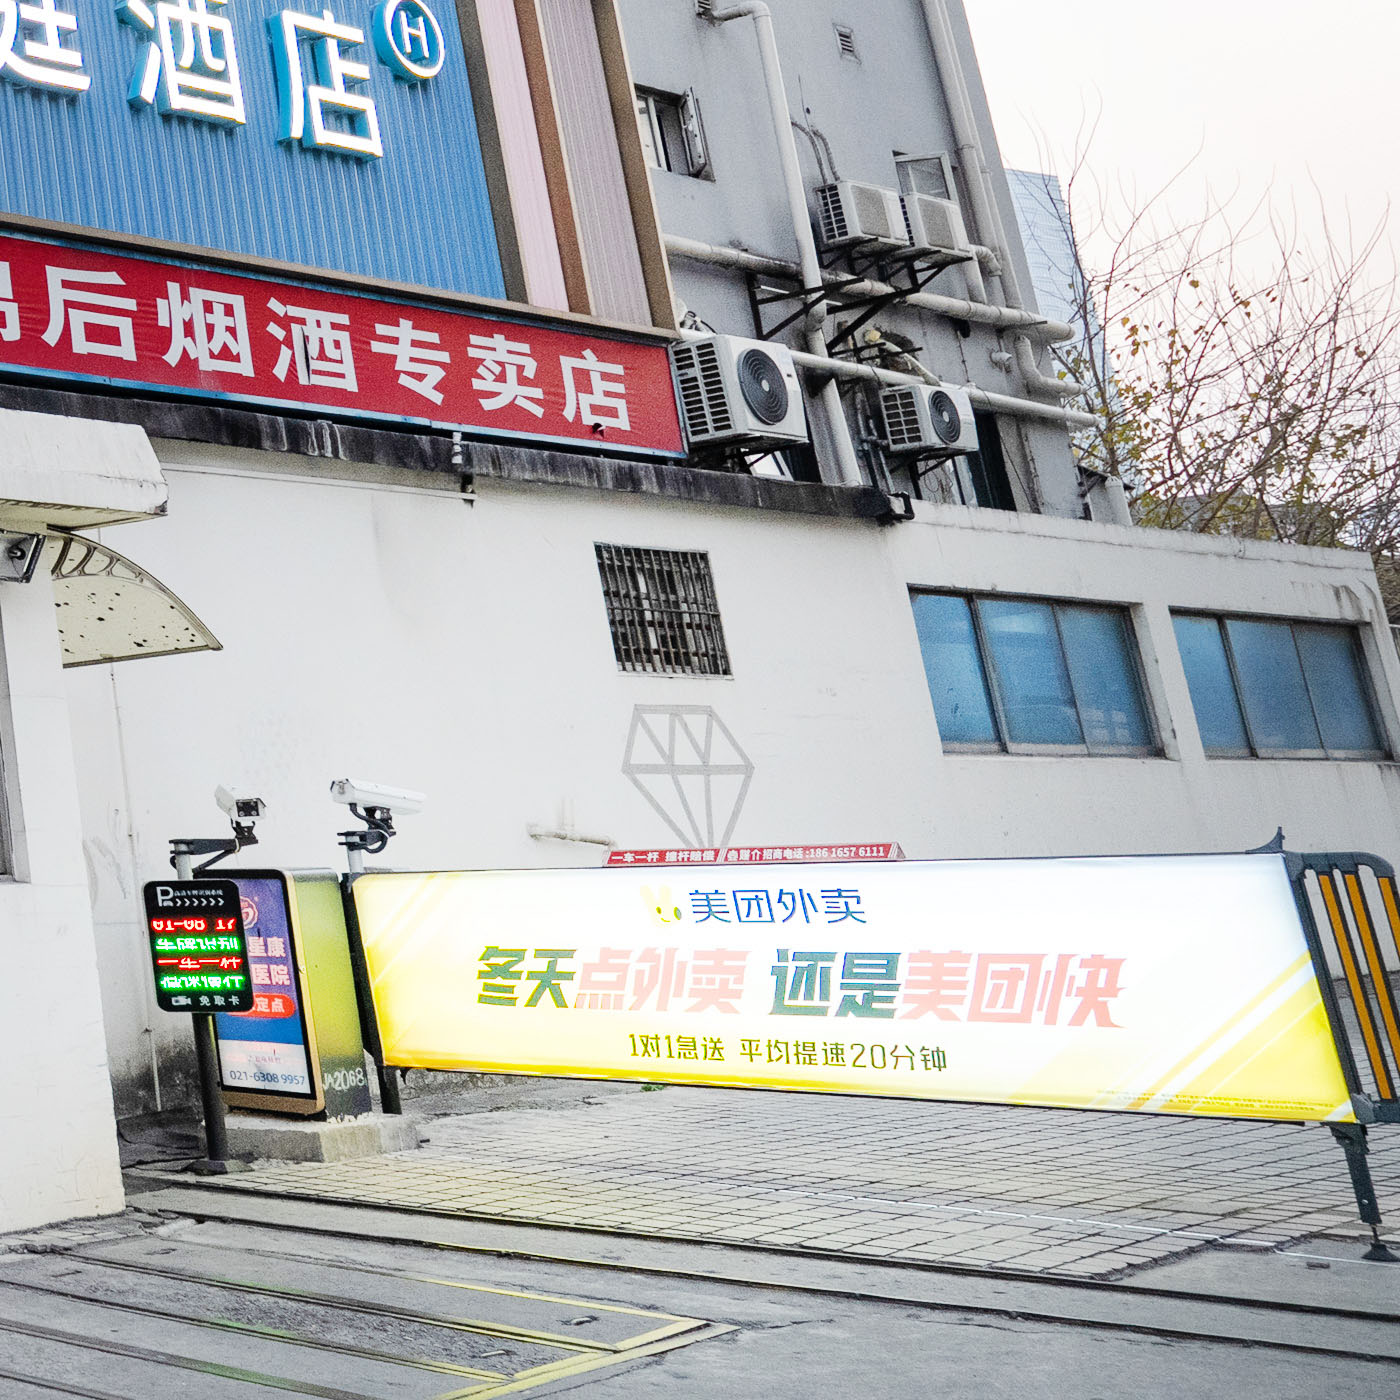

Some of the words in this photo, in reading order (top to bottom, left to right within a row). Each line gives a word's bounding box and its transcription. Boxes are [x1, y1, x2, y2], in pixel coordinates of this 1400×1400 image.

[832, 846, 856, 857] 1657
[859, 845, 885, 856] 6111
[689, 888, 867, 924] 美团外卖
[477, 945, 751, 1015] 冬天点外卖
[768, 948, 1128, 1028] 还是美团快
[199, 995, 240, 1007] 免取卡
[254, 996, 286, 1013] 定点
[630, 1033, 725, 1061] 1对1急送
[739, 1038, 948, 1073] 平均提速20分钟
[229, 1070, 280, 1084] 021-6308
